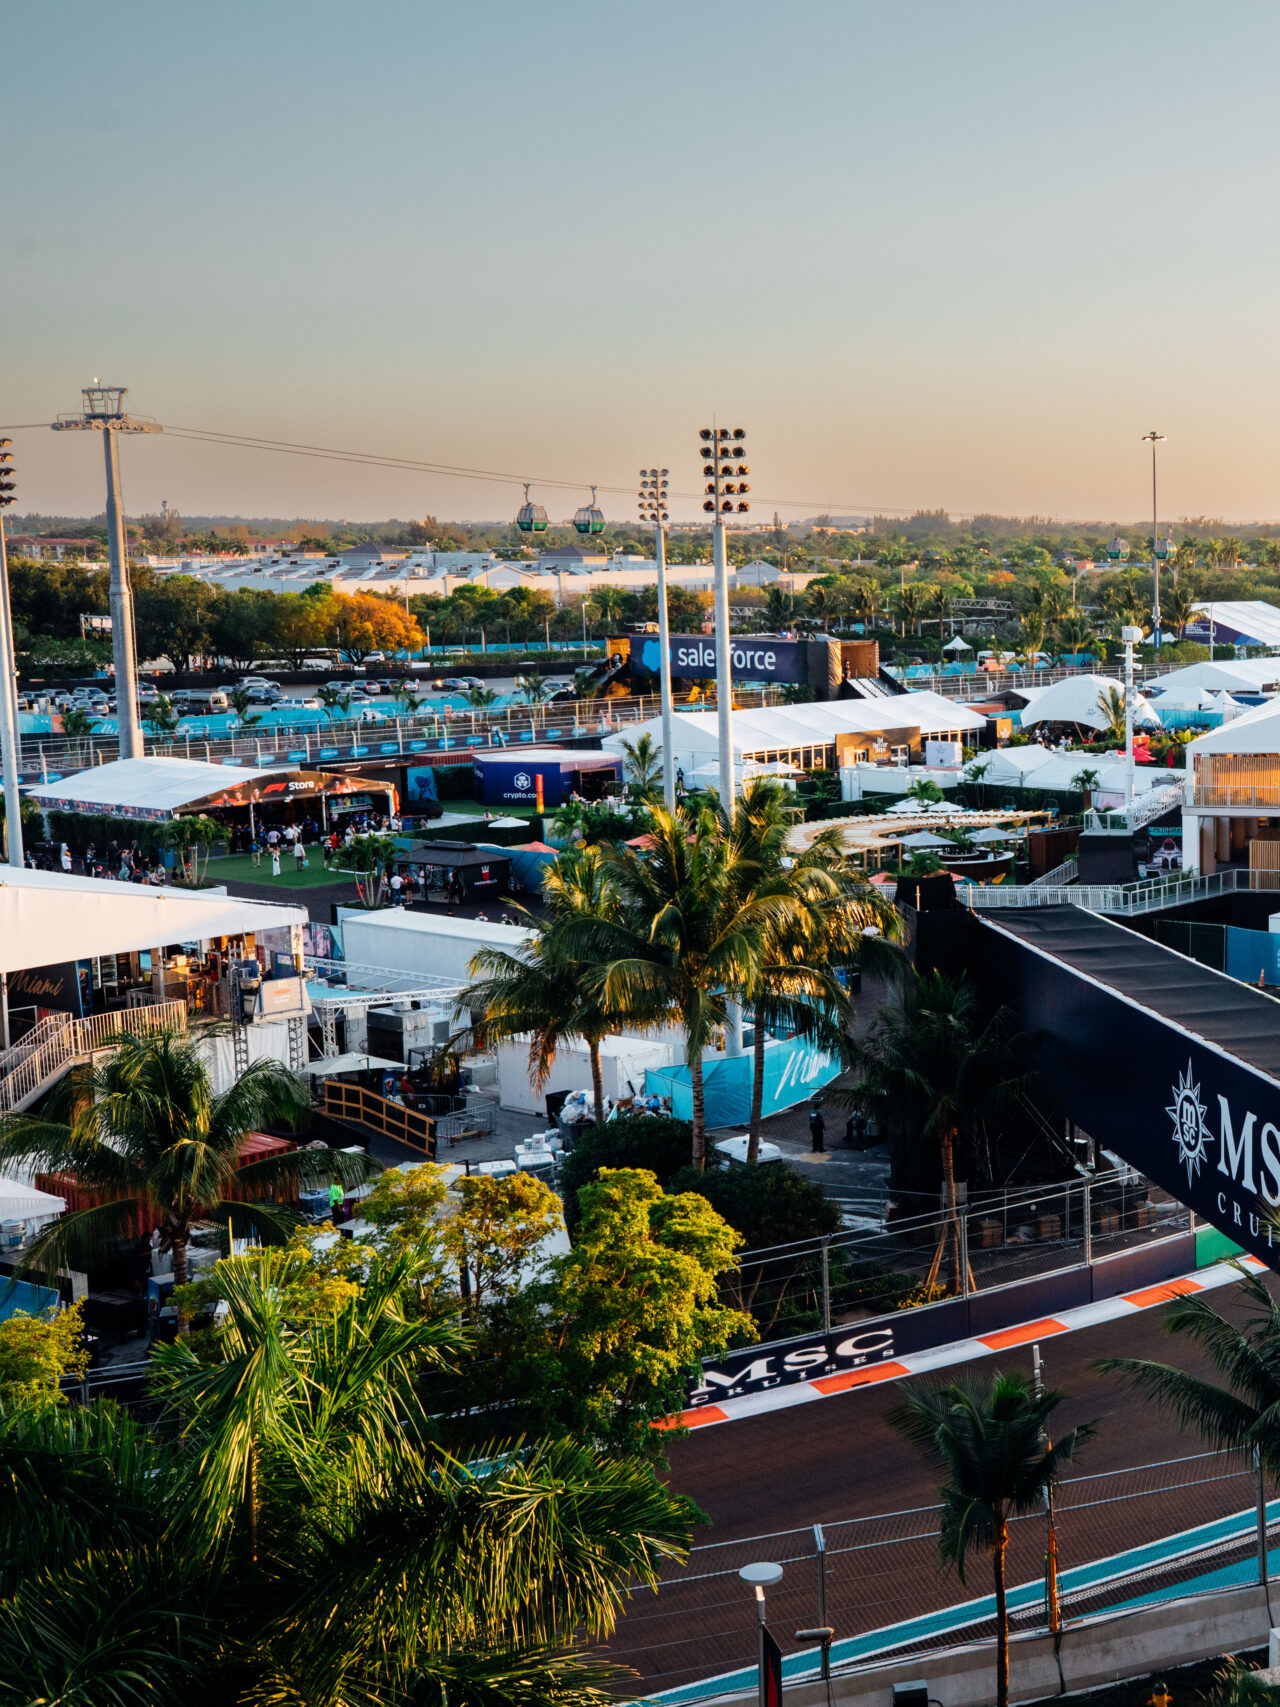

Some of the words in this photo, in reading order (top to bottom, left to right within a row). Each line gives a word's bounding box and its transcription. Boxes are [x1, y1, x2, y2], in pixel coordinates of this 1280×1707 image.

[678, 643, 777, 670] saleforce
[288, 780, 315, 790] Store
[690, 1328, 895, 1396] MSC
[690, 1348, 895, 1404] CRUISES
